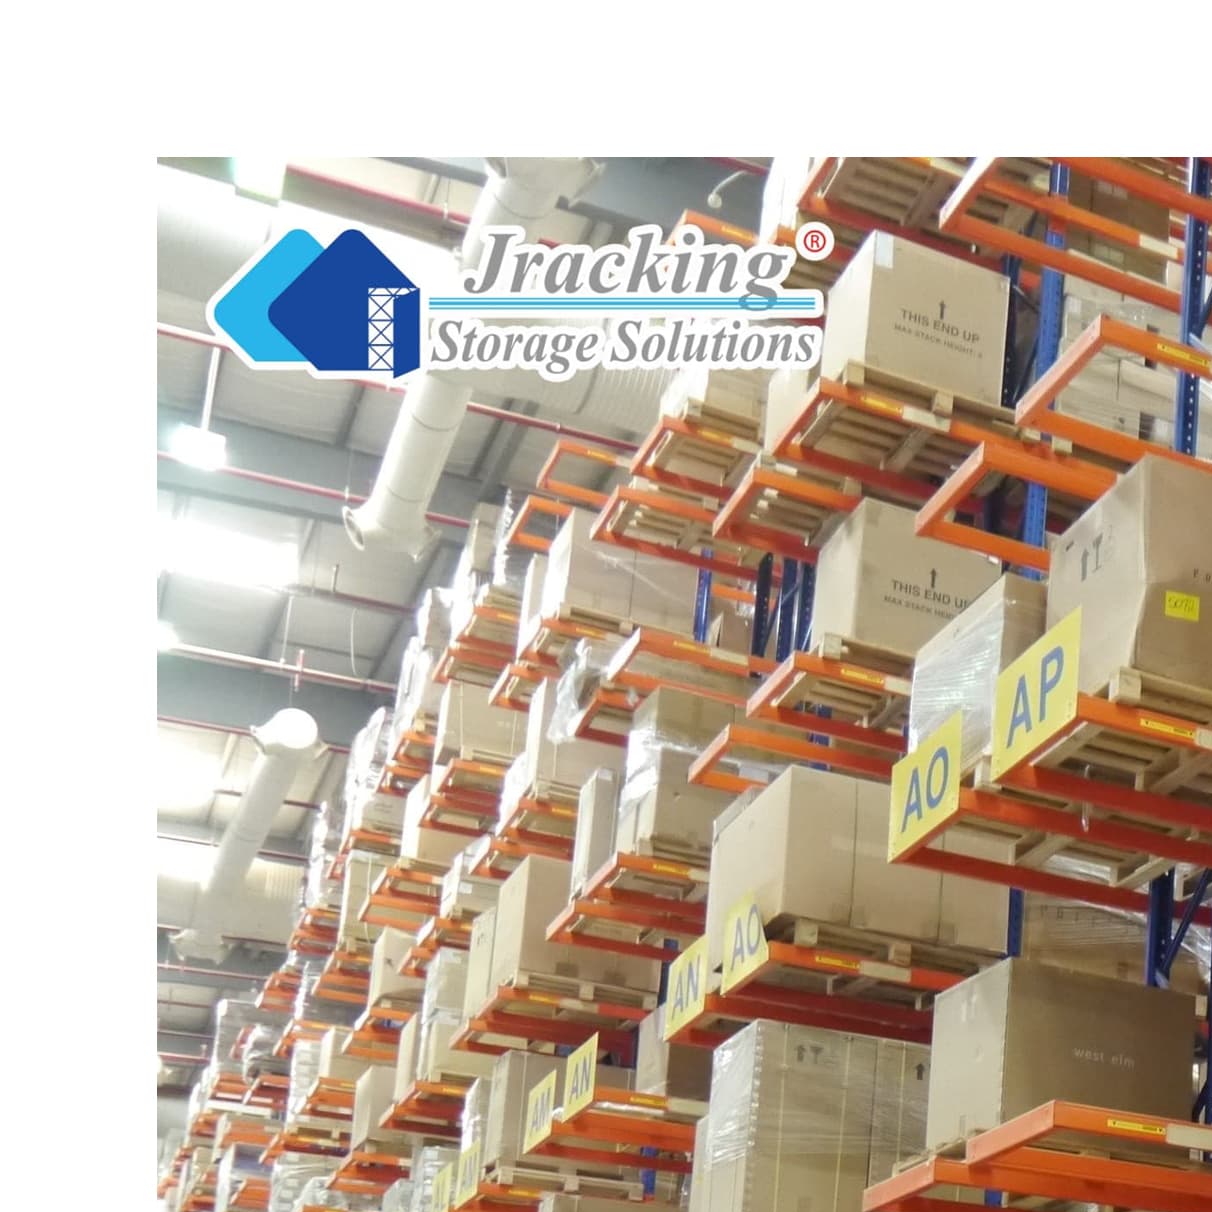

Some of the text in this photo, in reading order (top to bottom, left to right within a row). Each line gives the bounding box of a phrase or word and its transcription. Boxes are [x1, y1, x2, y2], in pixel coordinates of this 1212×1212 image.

[901, 308, 980, 344] THIS END UP
[891, 578, 921, 598] THIS
[924, 588, 951, 605] END
[1006, 645, 1065, 750] AP
[901, 746, 950, 833] AO
[730, 903, 761, 972] AO
[671, 953, 701, 1021] AN
[569, 1051, 593, 1105] AN
[1072, 1047, 1136, 1072] west elm
